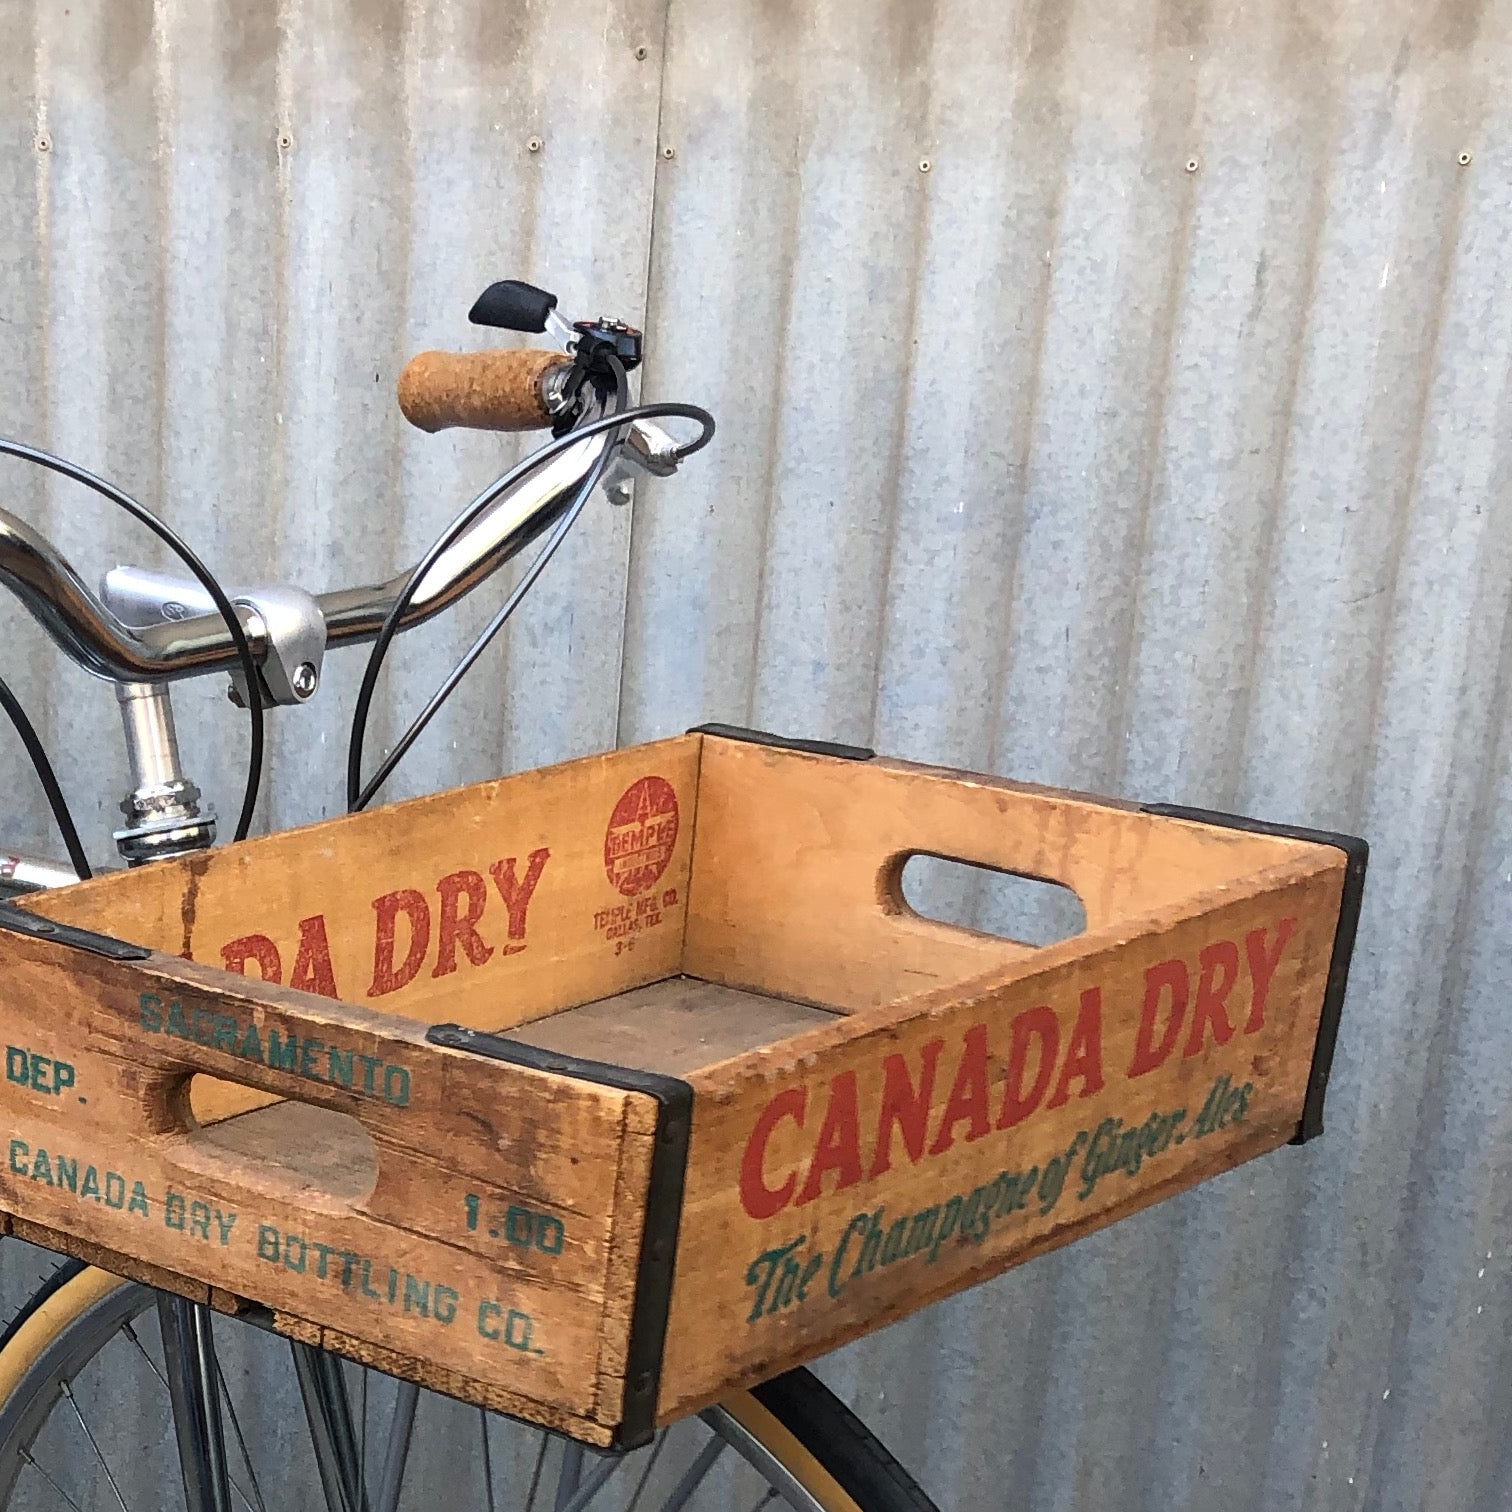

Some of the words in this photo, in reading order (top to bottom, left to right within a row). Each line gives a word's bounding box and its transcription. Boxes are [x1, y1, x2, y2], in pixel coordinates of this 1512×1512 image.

[366, 847, 551, 997] DRY
[6, 1045, 87, 1104] DEP.
[139, 993, 410, 1107] SACRAMENTO
[739, 987, 1105, 1219] CANADA
[1126, 918, 1299, 1079] DRY
[9, 1139, 149, 1217] CANADA
[165, 1191, 236, 1246] DRY
[258, 1224, 459, 1324] BOTTLING
[464, 1193, 565, 1256] 1.00
[745, 1235, 824, 1323] The
[828, 1166, 1039, 1298] Champagne
[1039, 1131, 1090, 1216] of
